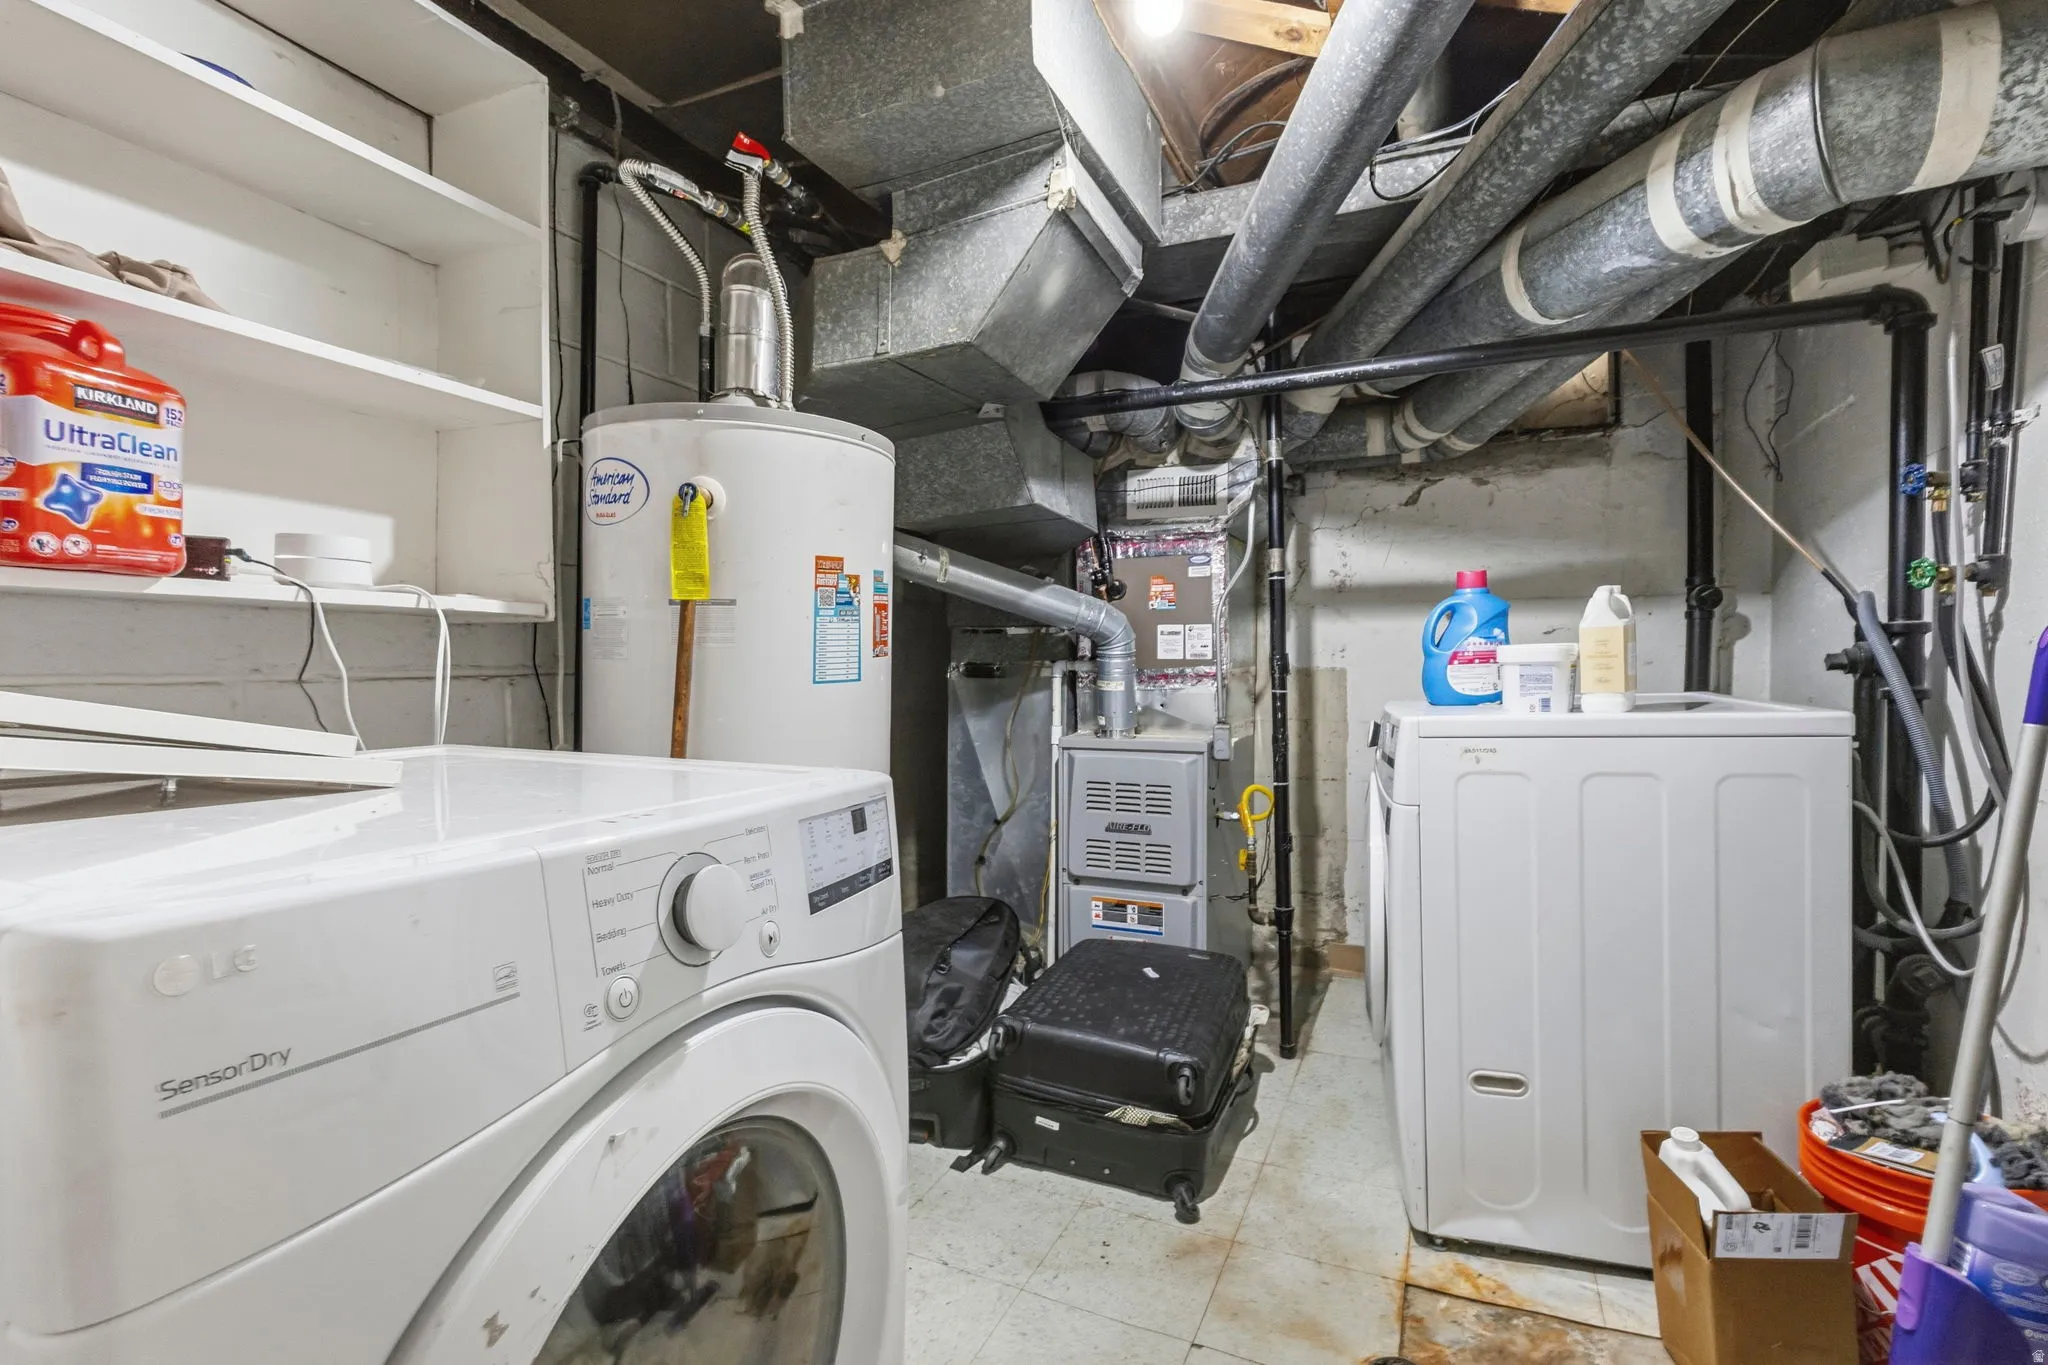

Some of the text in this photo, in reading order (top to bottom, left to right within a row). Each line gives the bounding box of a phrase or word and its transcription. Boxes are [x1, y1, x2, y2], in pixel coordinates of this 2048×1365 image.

[76, 386, 158, 415] KIRKLAND
[165, 407, 183, 422] 152
[44, 418, 178, 462] UltraClean
[590, 467, 635, 487] American
[587, 486, 634, 507] Standard
[587, 862, 614, 876] Normal
[592, 891, 634, 909] Heavy Duty
[596, 927, 627, 944] Bedding
[209, 944, 258, 981] LG
[601, 961, 627, 977] Towels
